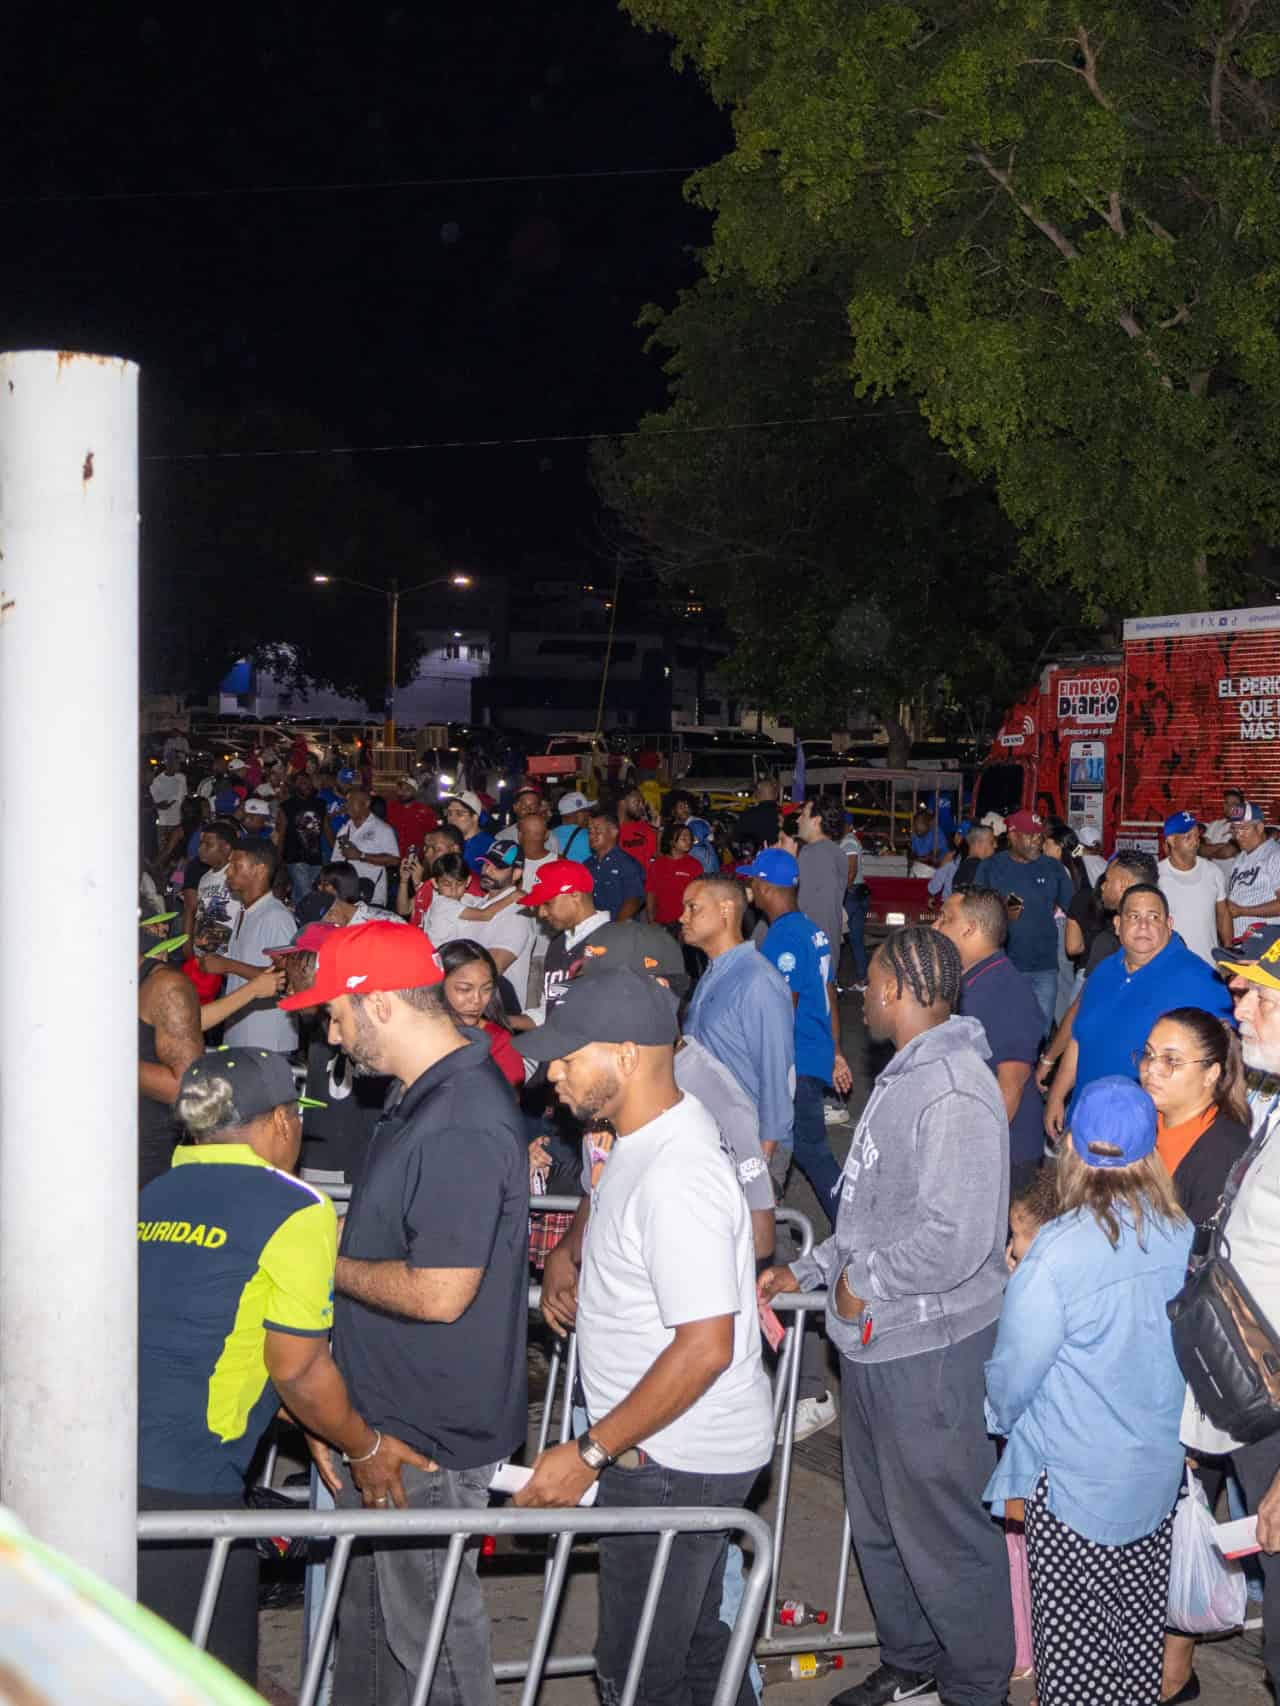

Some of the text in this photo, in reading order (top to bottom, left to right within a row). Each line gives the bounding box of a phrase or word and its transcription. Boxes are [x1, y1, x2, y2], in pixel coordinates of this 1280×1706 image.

[1069, 679, 1118, 696] nuevo
[1218, 680, 1236, 698] EL
[1240, 699, 1273, 718] QUE
[1241, 718, 1275, 740] MÁS
[136, 1221, 227, 1249] GURIDAD
